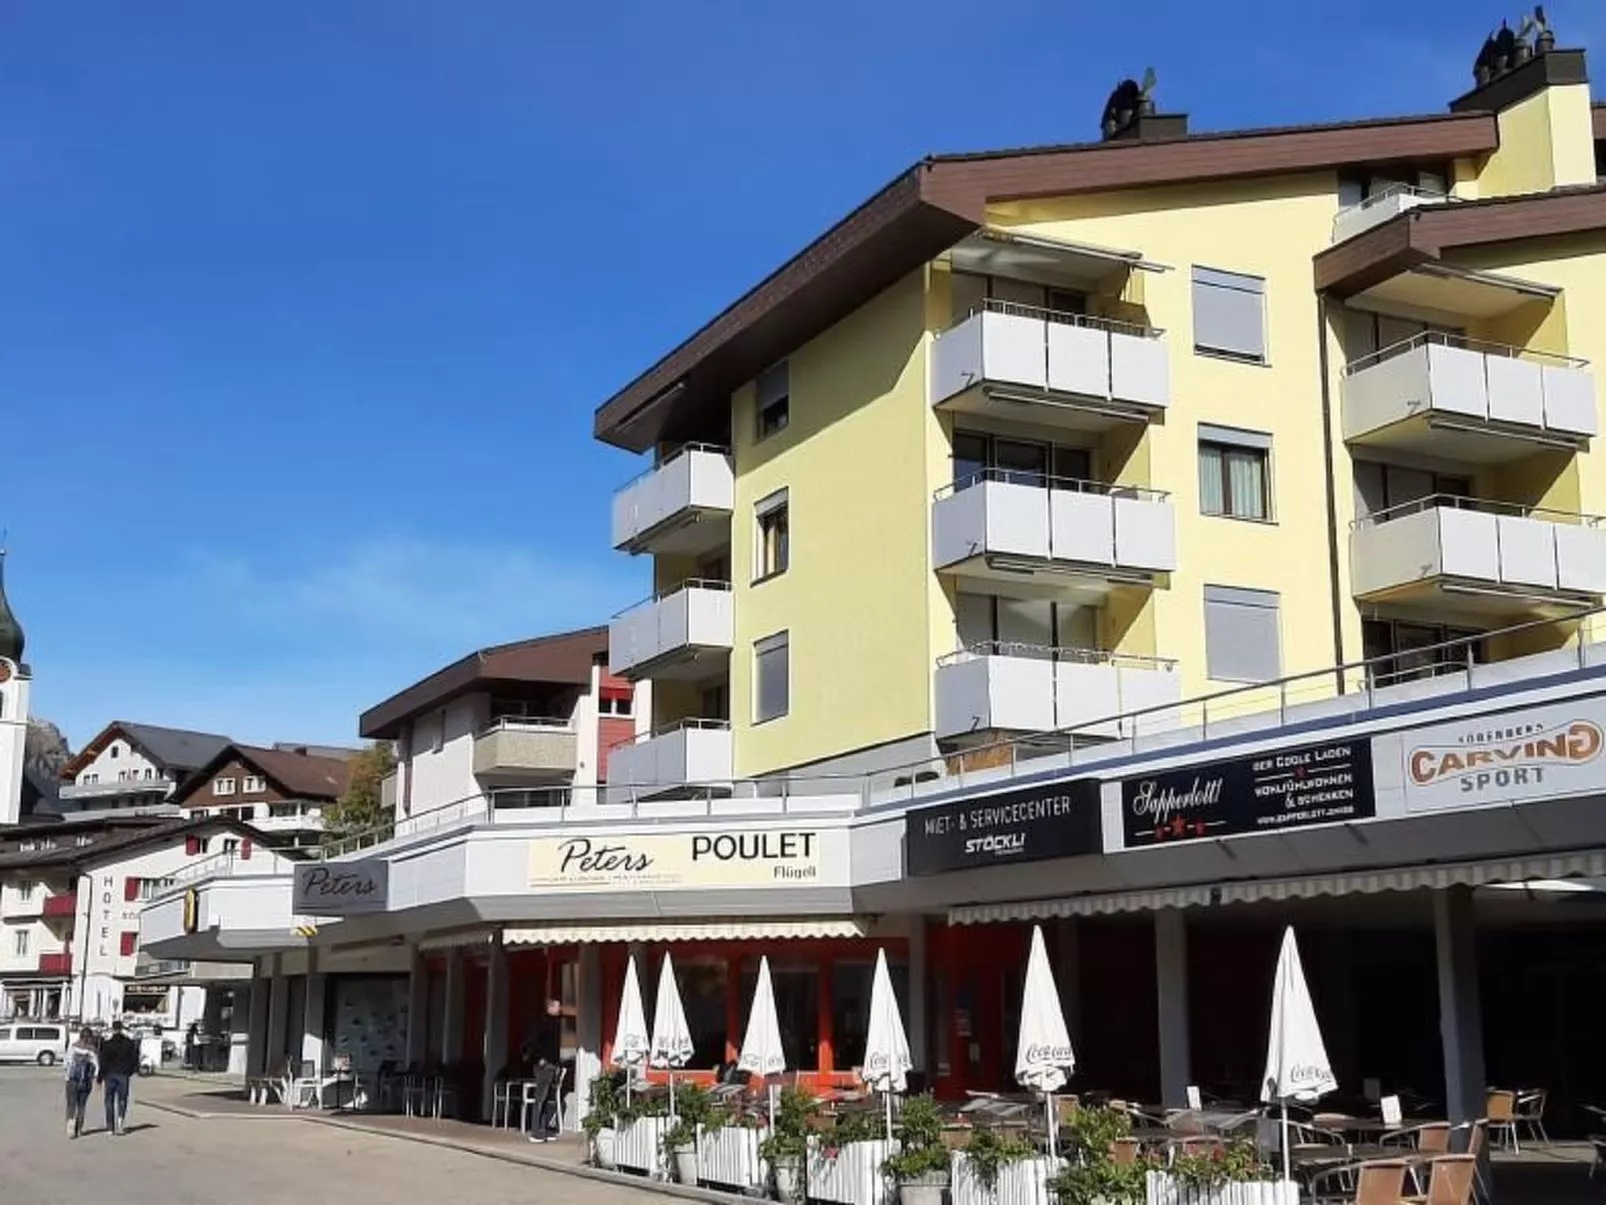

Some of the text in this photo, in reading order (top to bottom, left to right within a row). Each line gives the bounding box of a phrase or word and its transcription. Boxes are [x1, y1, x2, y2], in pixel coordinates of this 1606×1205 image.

[1315, 746, 1352, 760] LADEN
[1411, 724, 1600, 783] CARVING
[1460, 767, 1543, 792] SPORT
[970, 796, 1071, 828] SERVICECENTER
[1285, 793, 1296, 808] &
[558, 838, 653, 872] Peters
[692, 832, 816, 861] POULET
[302, 867, 377, 897] Peters
